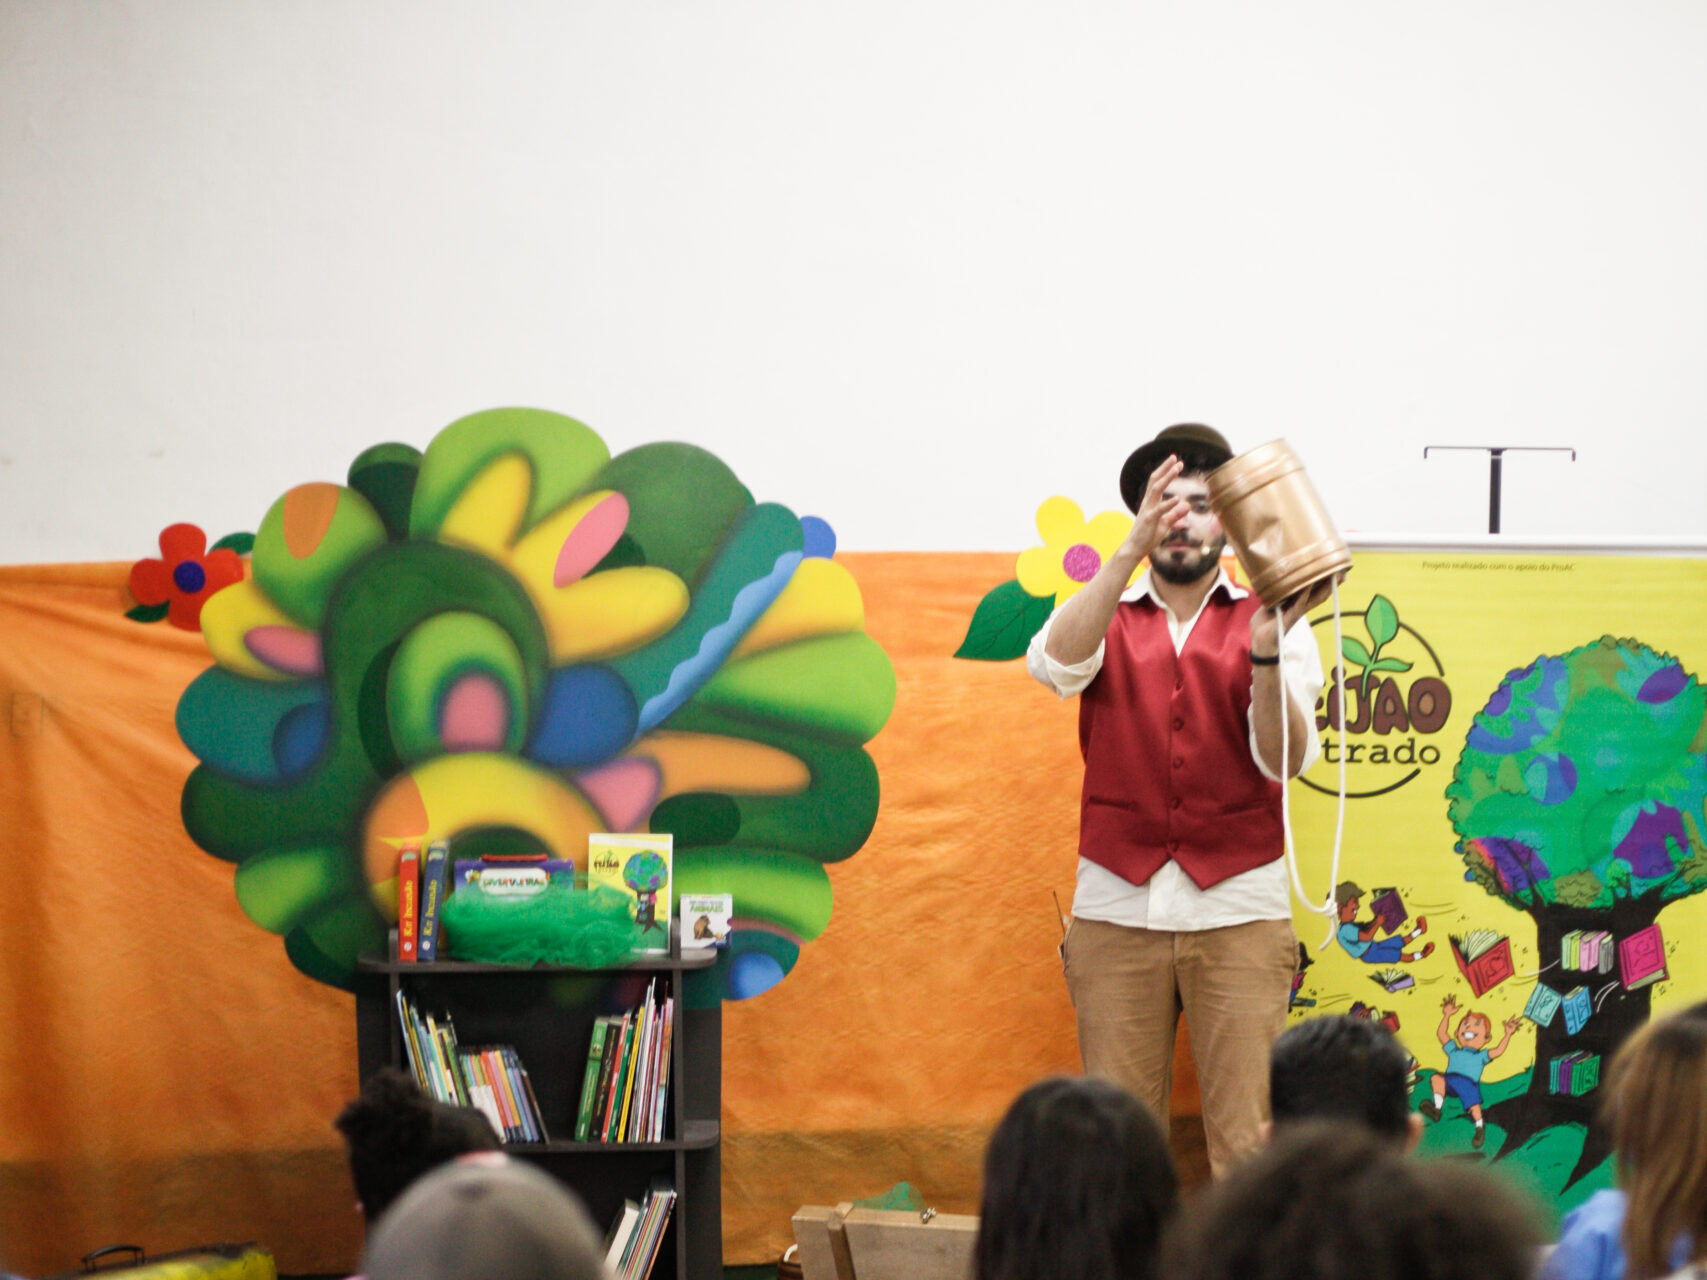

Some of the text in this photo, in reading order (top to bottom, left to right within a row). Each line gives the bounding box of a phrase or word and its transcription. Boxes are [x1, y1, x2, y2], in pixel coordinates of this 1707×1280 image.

[1422, 560, 1450, 572] Projeto
[1452, 560, 1487, 571] realizado
[1489, 563, 1506, 571] com
[1515, 562, 1537, 573] apoio
[1539, 561, 1550, 571] do
[1322, 737, 1441, 765] trado
